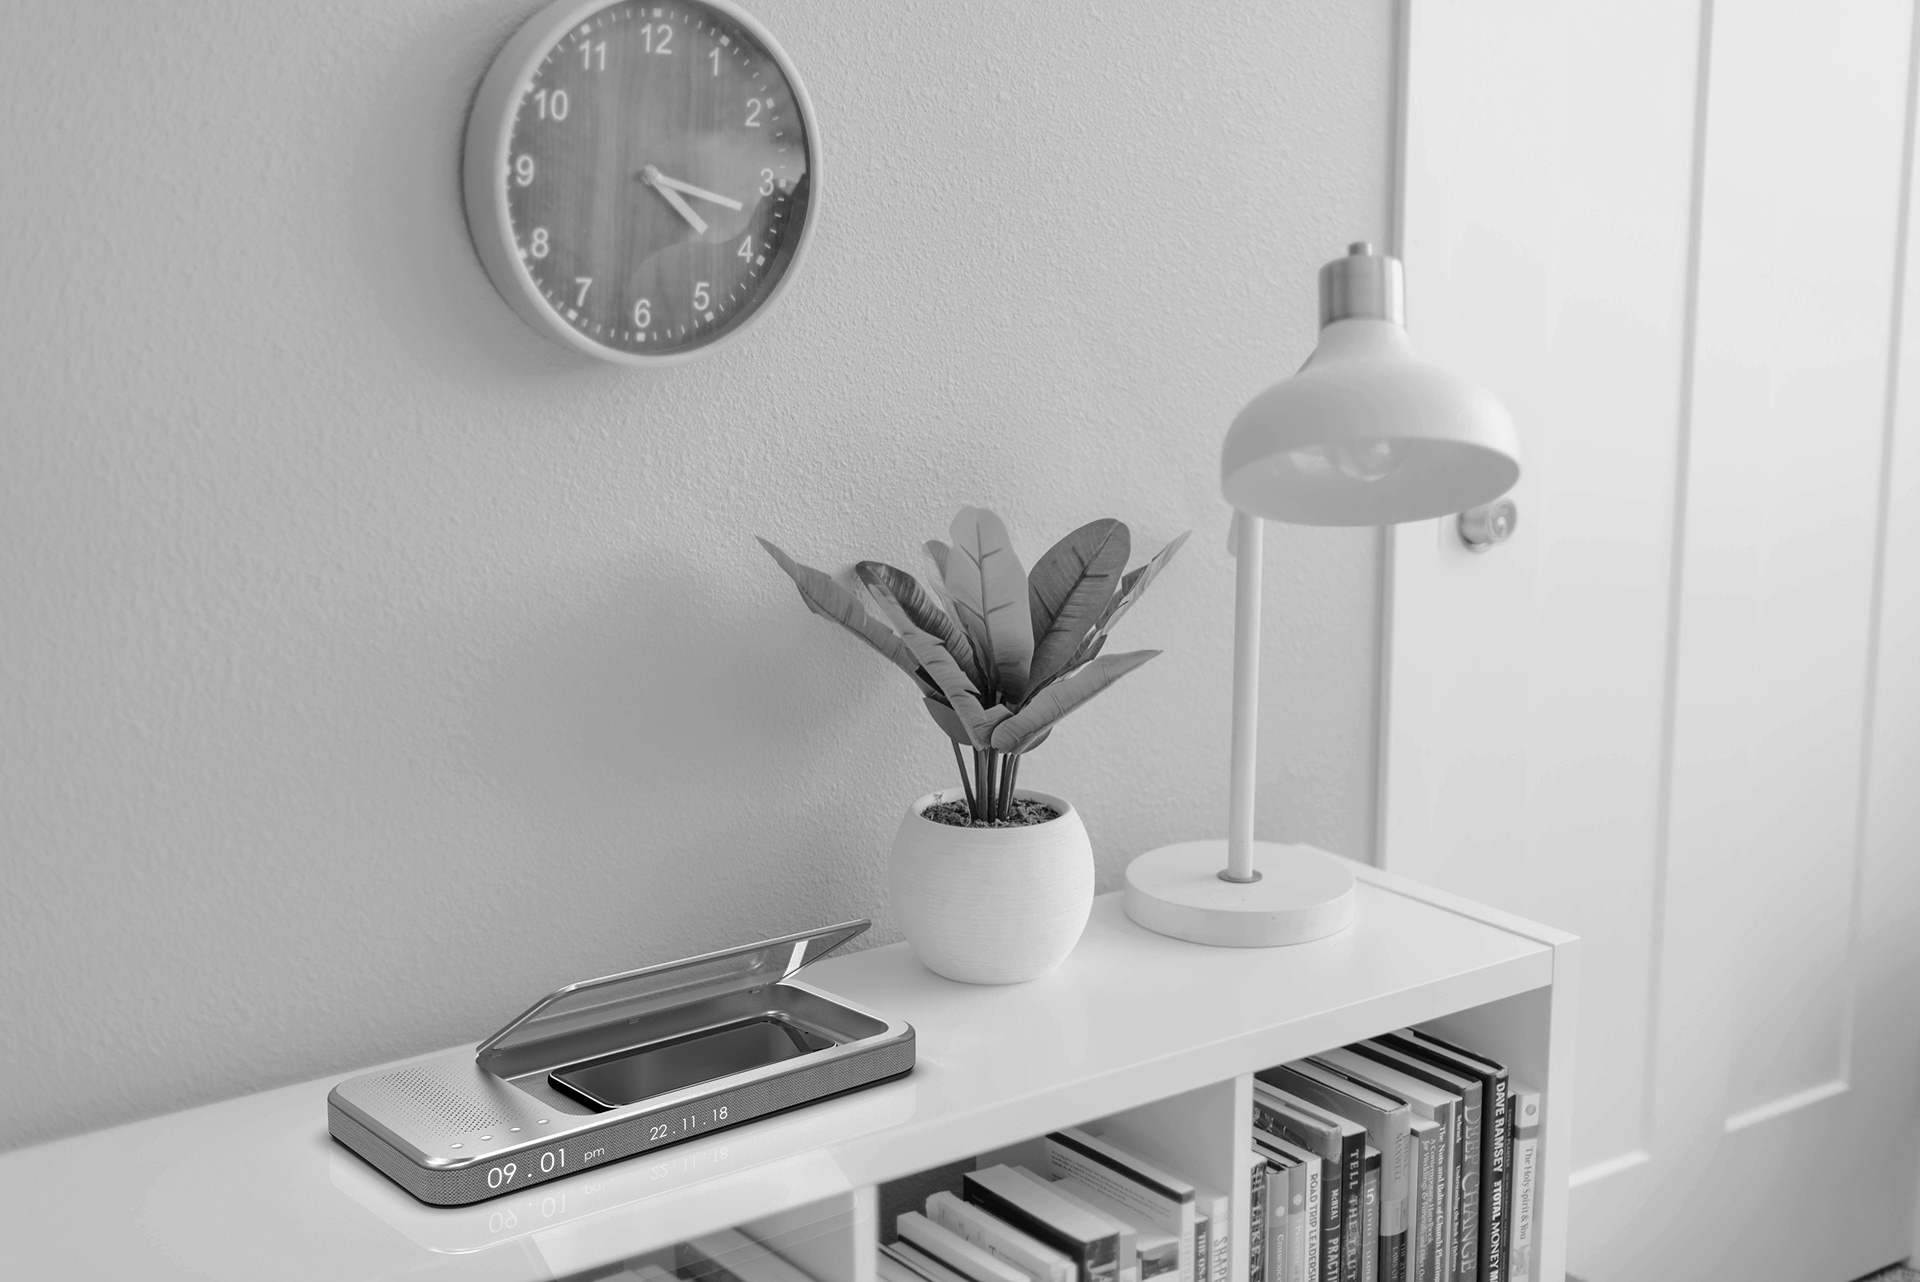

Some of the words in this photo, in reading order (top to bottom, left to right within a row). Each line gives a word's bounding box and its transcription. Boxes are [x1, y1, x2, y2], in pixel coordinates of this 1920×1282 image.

[640, 23, 673, 55] 12
[579, 40, 607, 71] 11
[708, 46, 720, 76] 1
[534, 89, 568, 120] 10
[744, 98, 761, 127] 2
[515, 154, 535, 186] 9
[758, 168, 774, 196] 3
[531, 227, 549, 258] 8
[737, 235, 753, 262] 4
[575, 277, 592, 307] 7
[693, 282, 710, 310] 5
[634, 299, 652, 328] 6
[1495, 1081, 1506, 1116] DAVE
[648, 1123, 670, 1143] 22
[682, 1117, 698, 1133] 11
[711, 1105, 729, 1121] 18
[1438, 1125, 1446, 1142] The
[1464, 1104, 1481, 1165] DEEP
[1394, 1132, 1403, 1183] MAXWELL
[1437, 1143, 1445, 1165] Nuts
[1493, 1119, 1505, 1172] RAMSEY
[1524, 1146, 1533, 1165] The
[486, 1162, 519, 1190] 09
[540, 1148, 568, 1174] 01
[584, 1147, 606, 1162] pm
[1349, 1149, 1360, 1190] TELL
[1421, 1152, 1429, 1191] Weddings
[1521, 1166, 1532, 1187] Holy
[1309, 1173, 1319, 1203] ROAD
[1366, 1188, 1374, 1205] 5
[1436, 1184, 1444, 1205] Bolts
[1520, 1189, 1530, 1213] Spirit
[1309, 1204, 1318, 1228] TRIP
[1330, 1188, 1339, 1220] McNEAL
[1348, 1195, 1358, 1230] THE
[1436, 1206, 1443, 1215] of
[1491, 1187, 1502, 1220] TOTAL
[1521, 1214, 1528, 1222] &
[1251, 1204, 1261, 1257] LIKE
[1435, 1216, 1443, 1247] Church
[1461, 1172, 1479, 1273] CHANGE
[1520, 1223, 1528, 1240] You
[1198, 1232, 1206, 1256] THE
[1489, 1222, 1500, 1268] MONEY
[1251, 1264, 1260, 1275] A
[1391, 1269, 1398, 1280] OF
